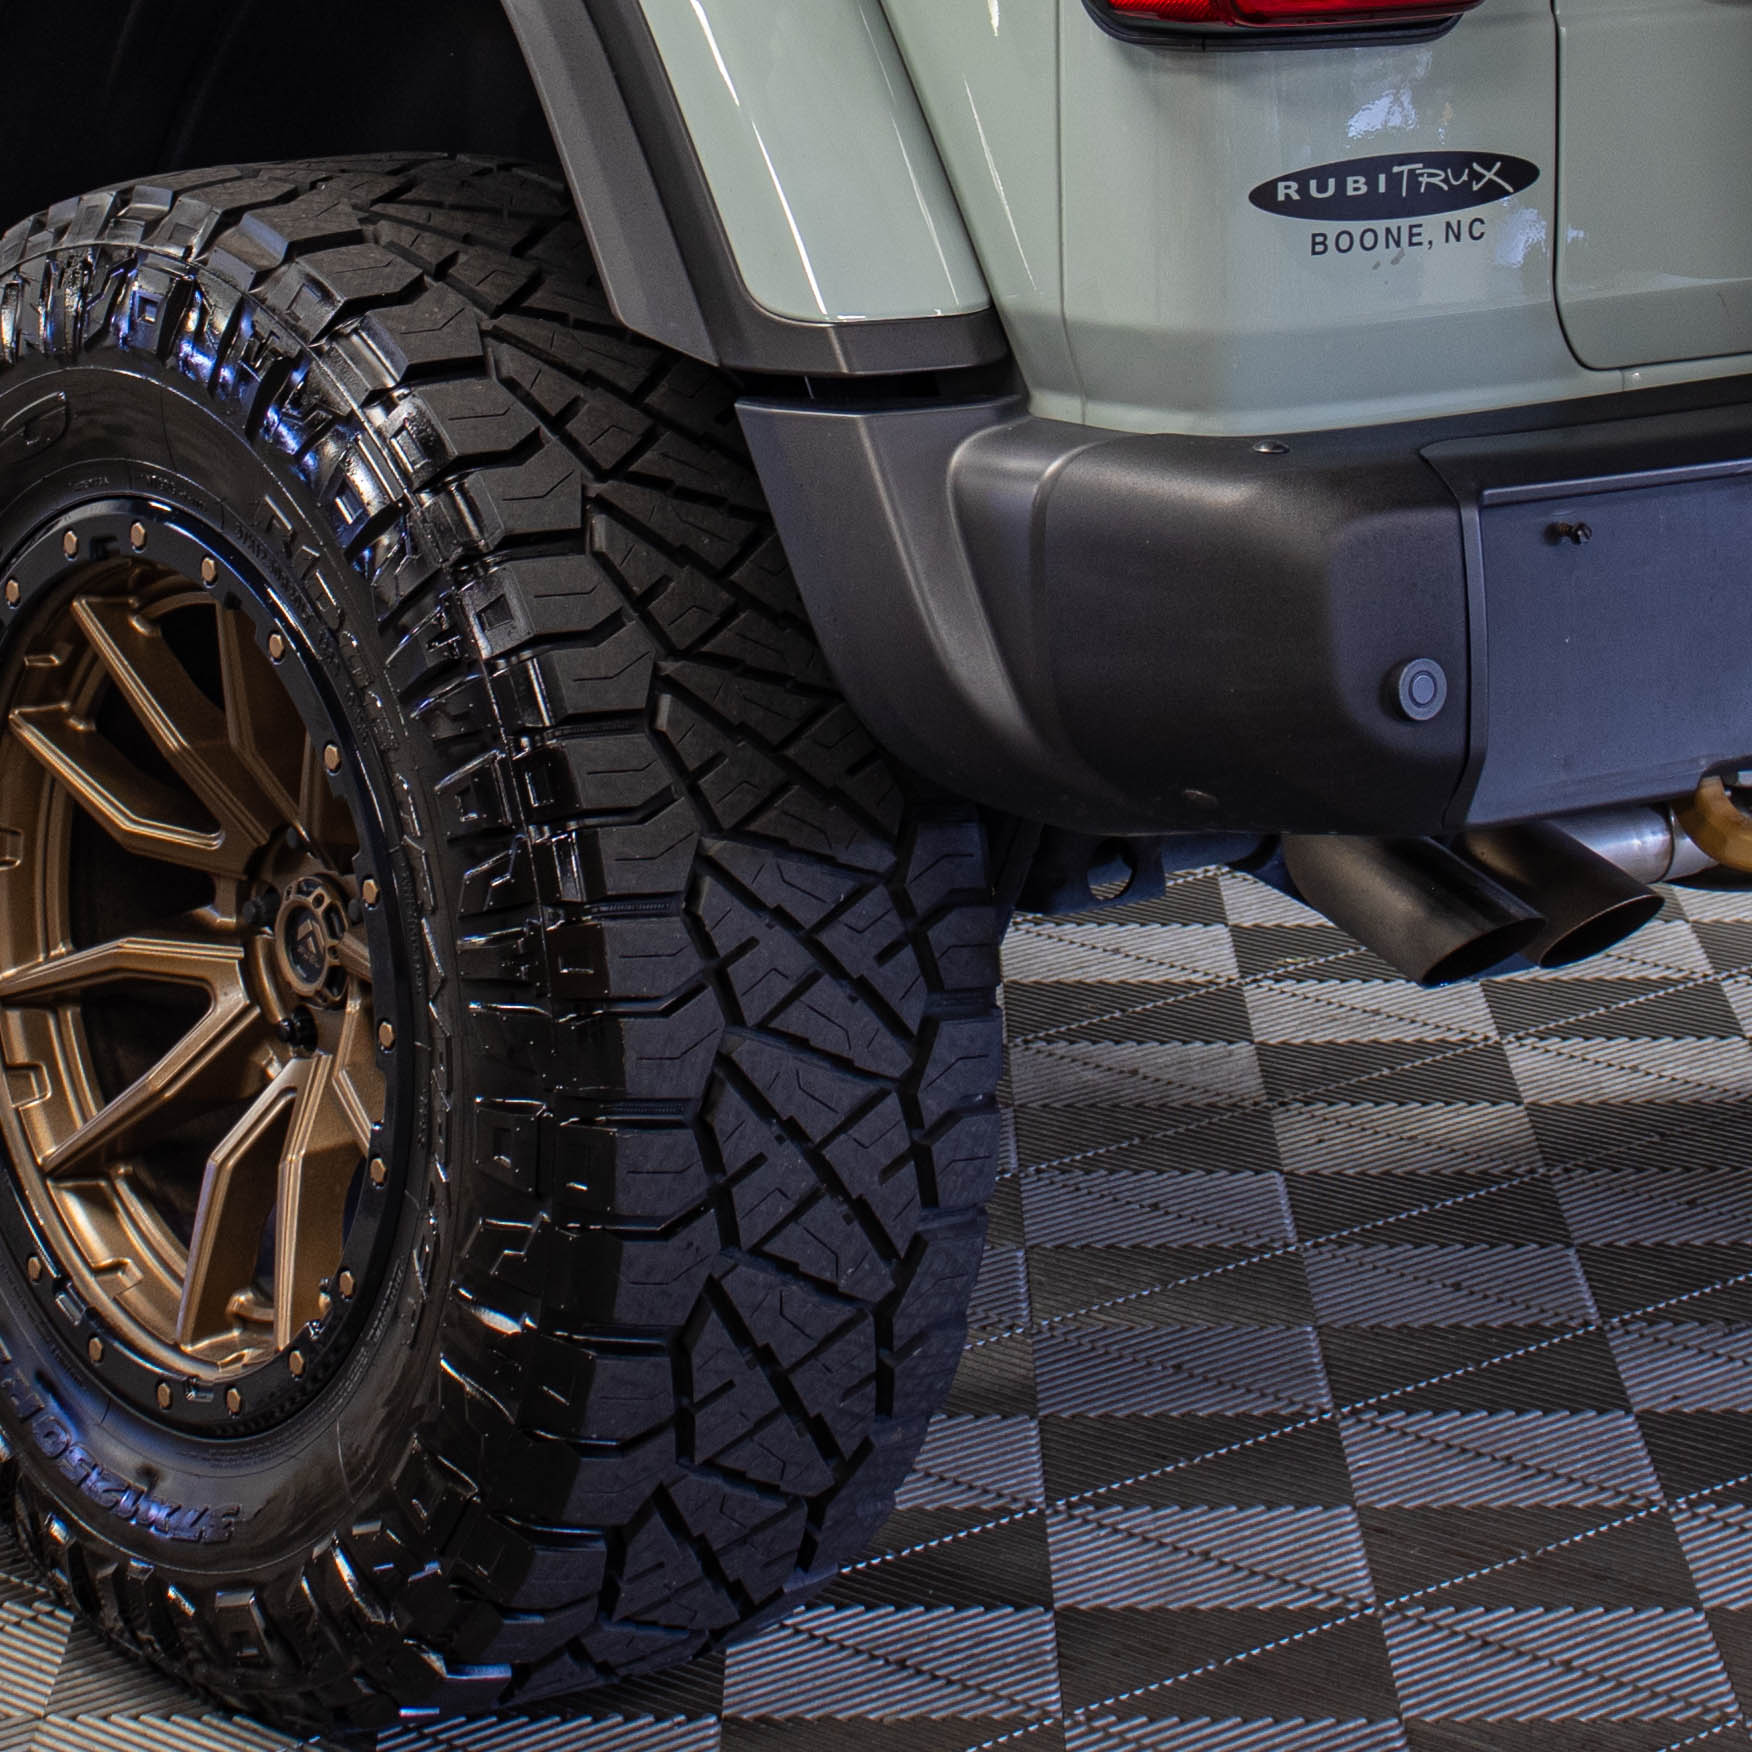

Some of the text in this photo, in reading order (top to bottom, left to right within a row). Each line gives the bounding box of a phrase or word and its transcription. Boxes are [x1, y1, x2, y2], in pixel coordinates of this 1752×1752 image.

[1276, 160, 1515, 202] RUBITRUX
[1310, 217, 1486, 256] BOONE, NC
